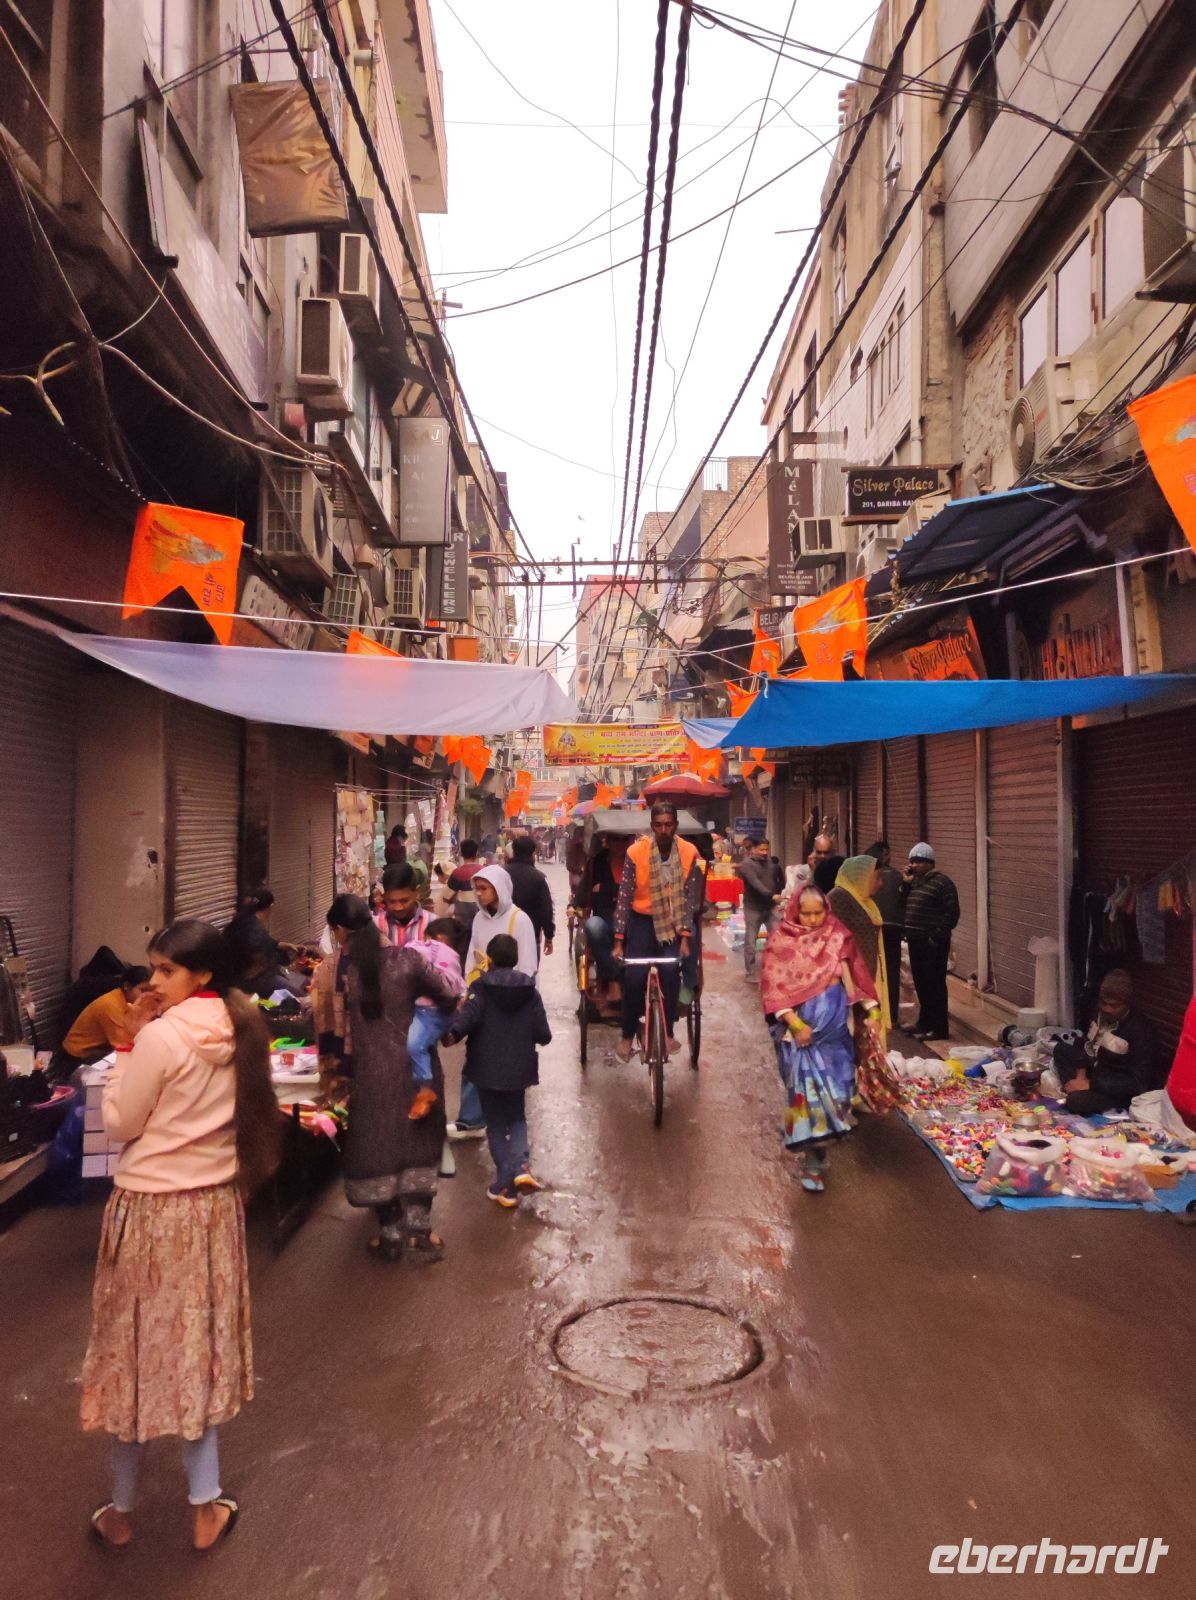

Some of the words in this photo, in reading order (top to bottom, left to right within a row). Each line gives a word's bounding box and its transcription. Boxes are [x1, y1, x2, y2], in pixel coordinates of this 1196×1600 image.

[852, 478, 890, 496] Silver
[892, 476, 934, 496] Palace
[443, 543, 456, 614] JEWELLERS
